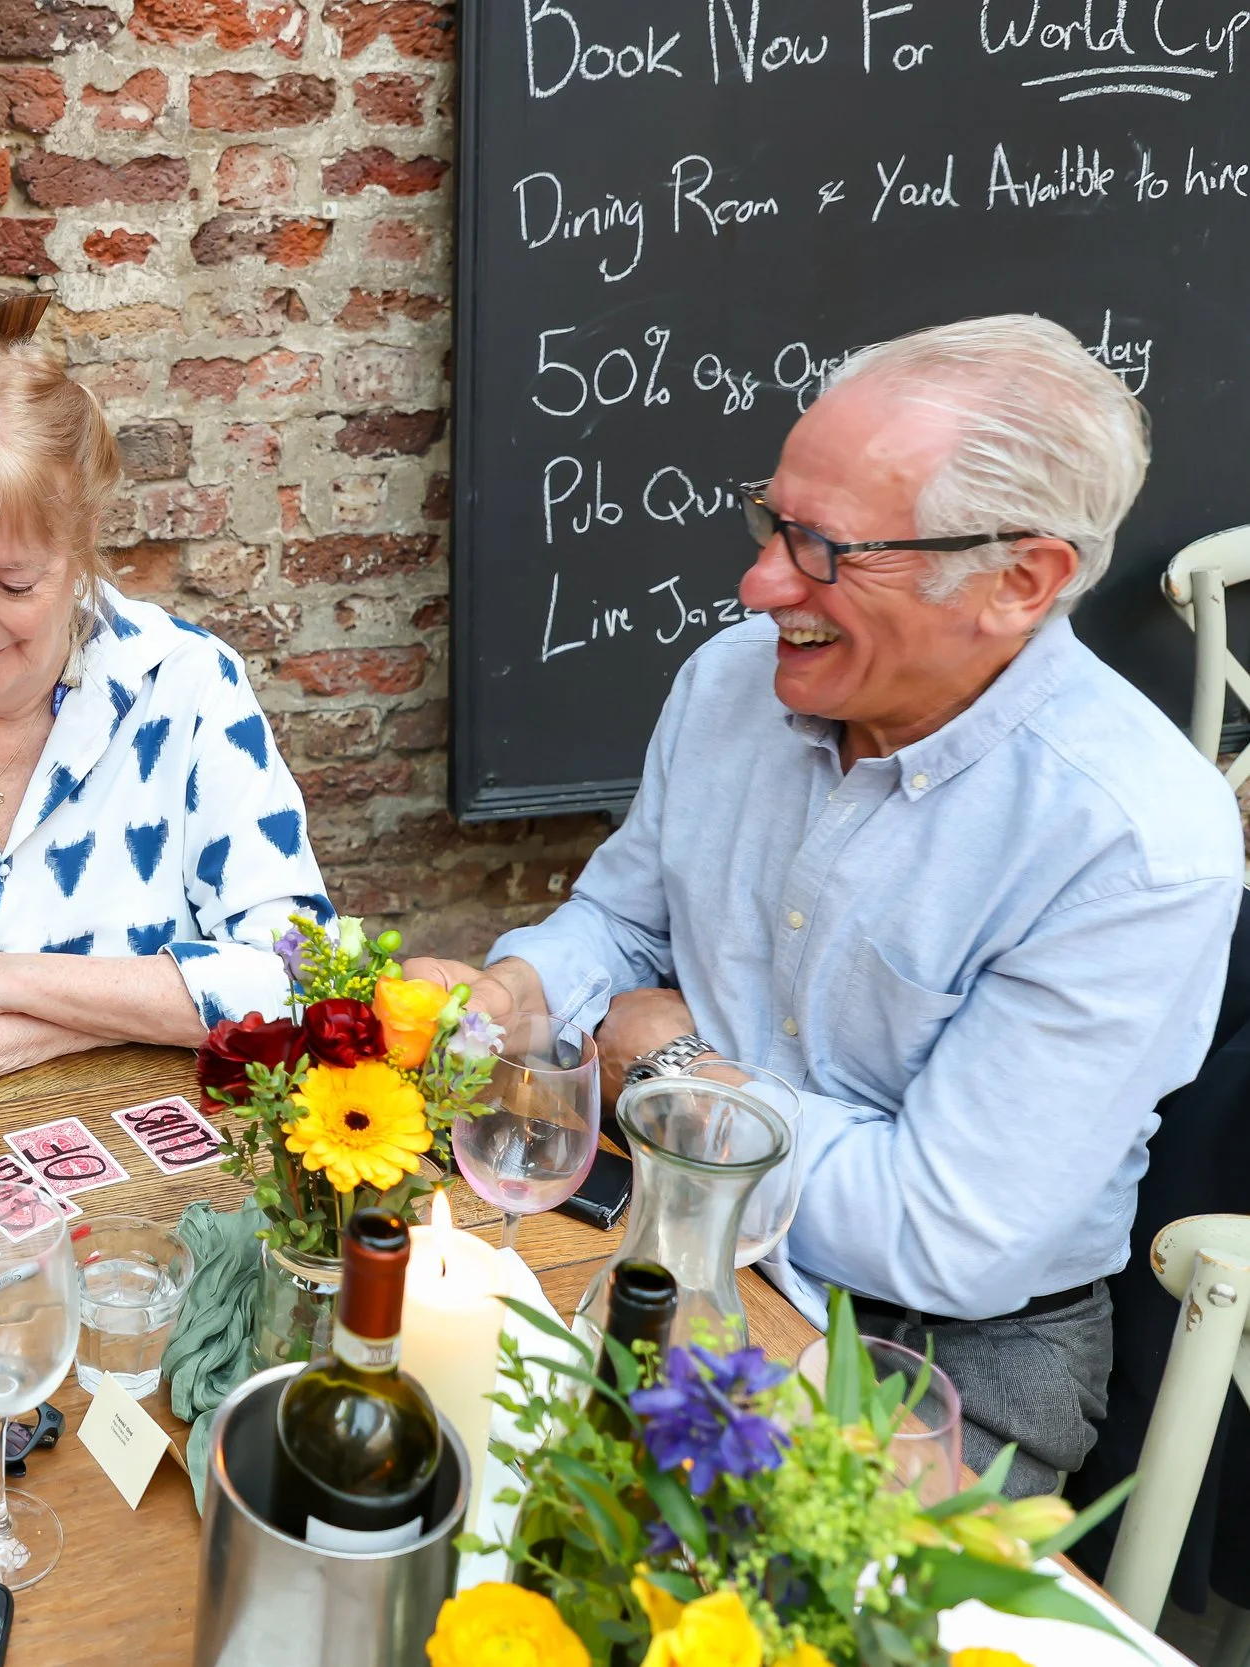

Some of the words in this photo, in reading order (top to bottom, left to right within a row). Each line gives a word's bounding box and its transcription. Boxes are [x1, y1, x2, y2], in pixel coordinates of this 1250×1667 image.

[523, 0, 683, 98] Book
[707, 0, 828, 84] Now
[862, 0, 934, 73] For
[979, 0, 1136, 54] World
[1153, 0, 1250, 73] Cup
[512, 171, 644, 283] Dining
[671, 154, 779, 236] Room
[871, 154, 960, 222] Yard
[1133, 149, 1169, 202] to
[1184, 146, 1250, 197] hire
[531, 325, 671, 416] 50%
[693, 353, 760, 415] Off
[543, 456, 623, 544] Pub
[642, 465, 740, 525] Qui
[541, 571, 634, 663] Live
[21, 1143, 107, 1181] OF
[124, 1104, 227, 1166] CLUBS
